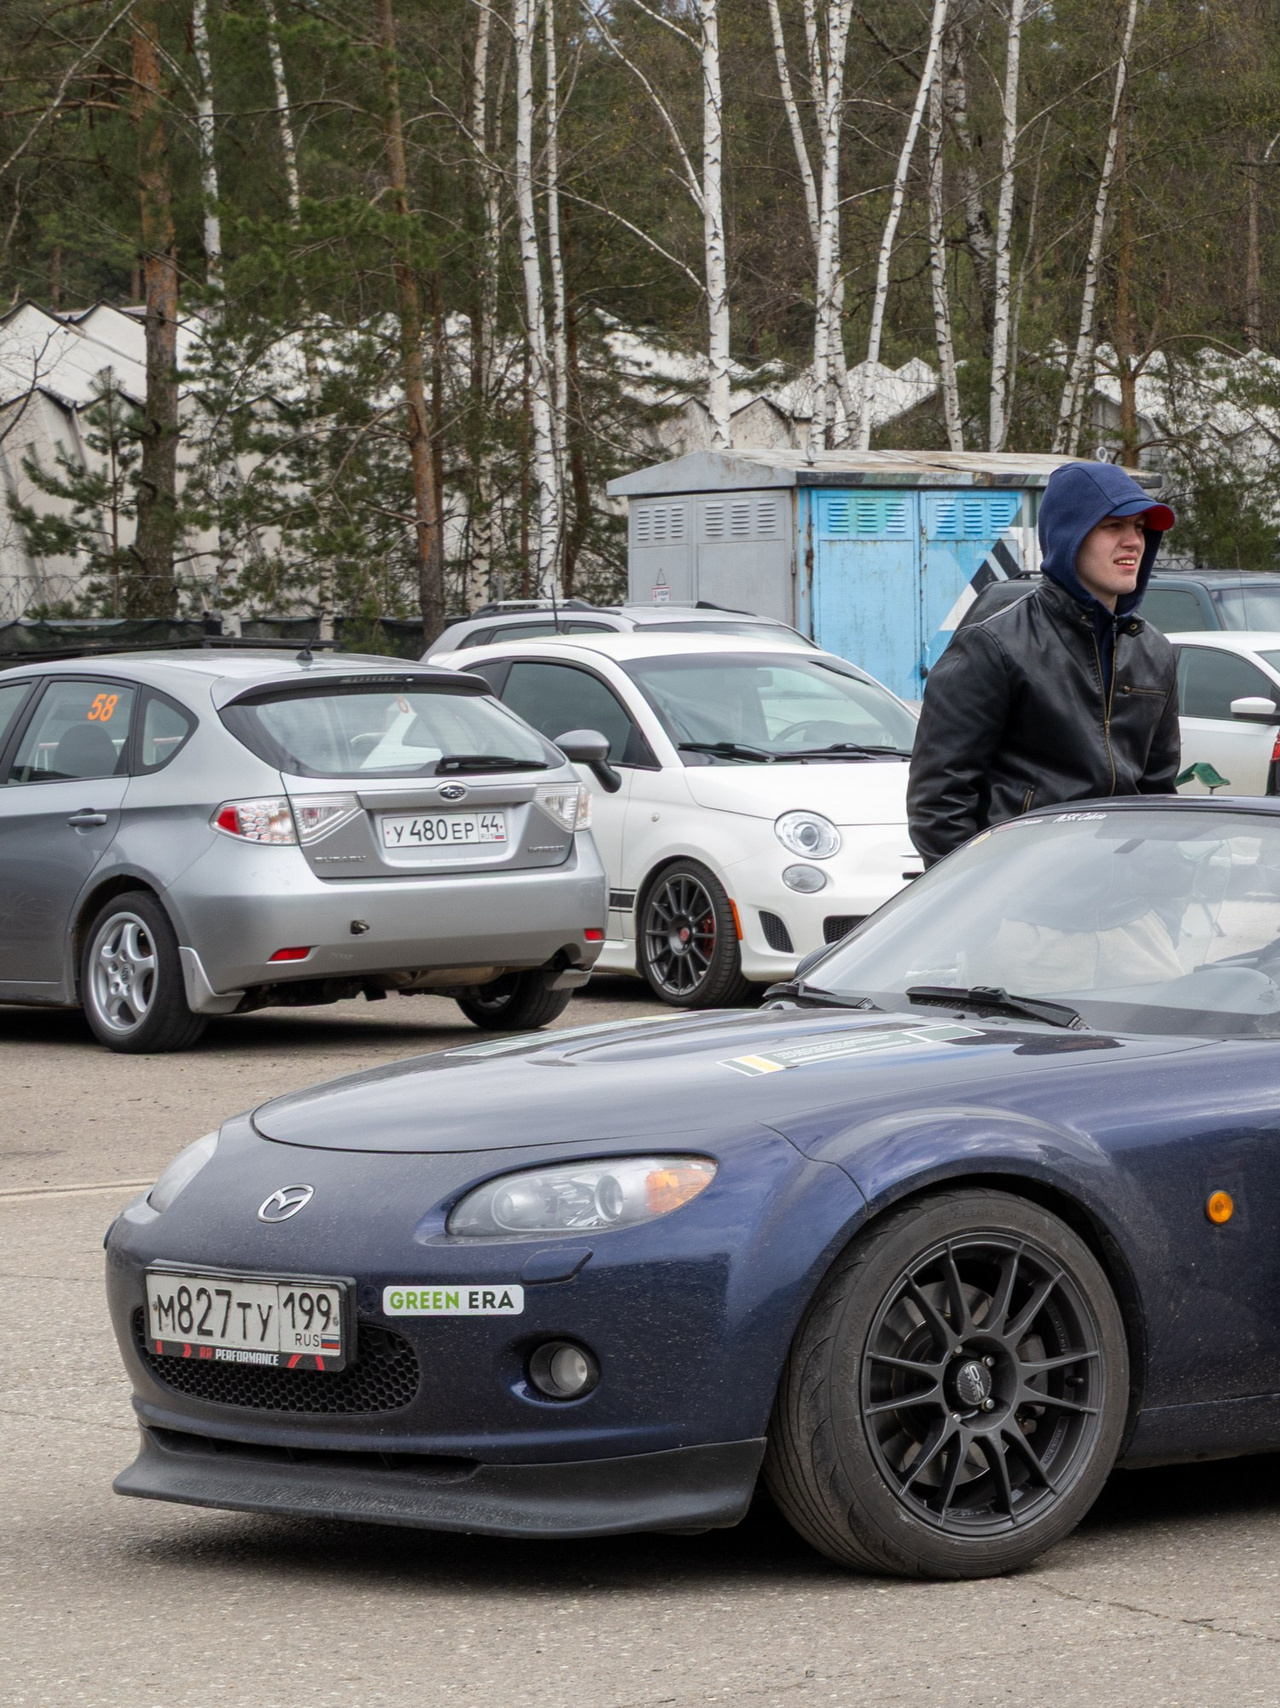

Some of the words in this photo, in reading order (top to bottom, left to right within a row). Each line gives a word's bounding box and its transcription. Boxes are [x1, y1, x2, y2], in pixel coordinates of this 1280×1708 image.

[87, 693, 118, 722] 58
[481, 815, 500, 833] 44
[389, 1291, 460, 1310] GREEN
[468, 1290, 515, 1309] ERA
[157, 1284, 273, 1342] М827ТУ
[283, 1291, 332, 1332] 199
[295, 1333, 320, 1347] RUS
[215, 1348, 280, 1366] PERFORMANCE
